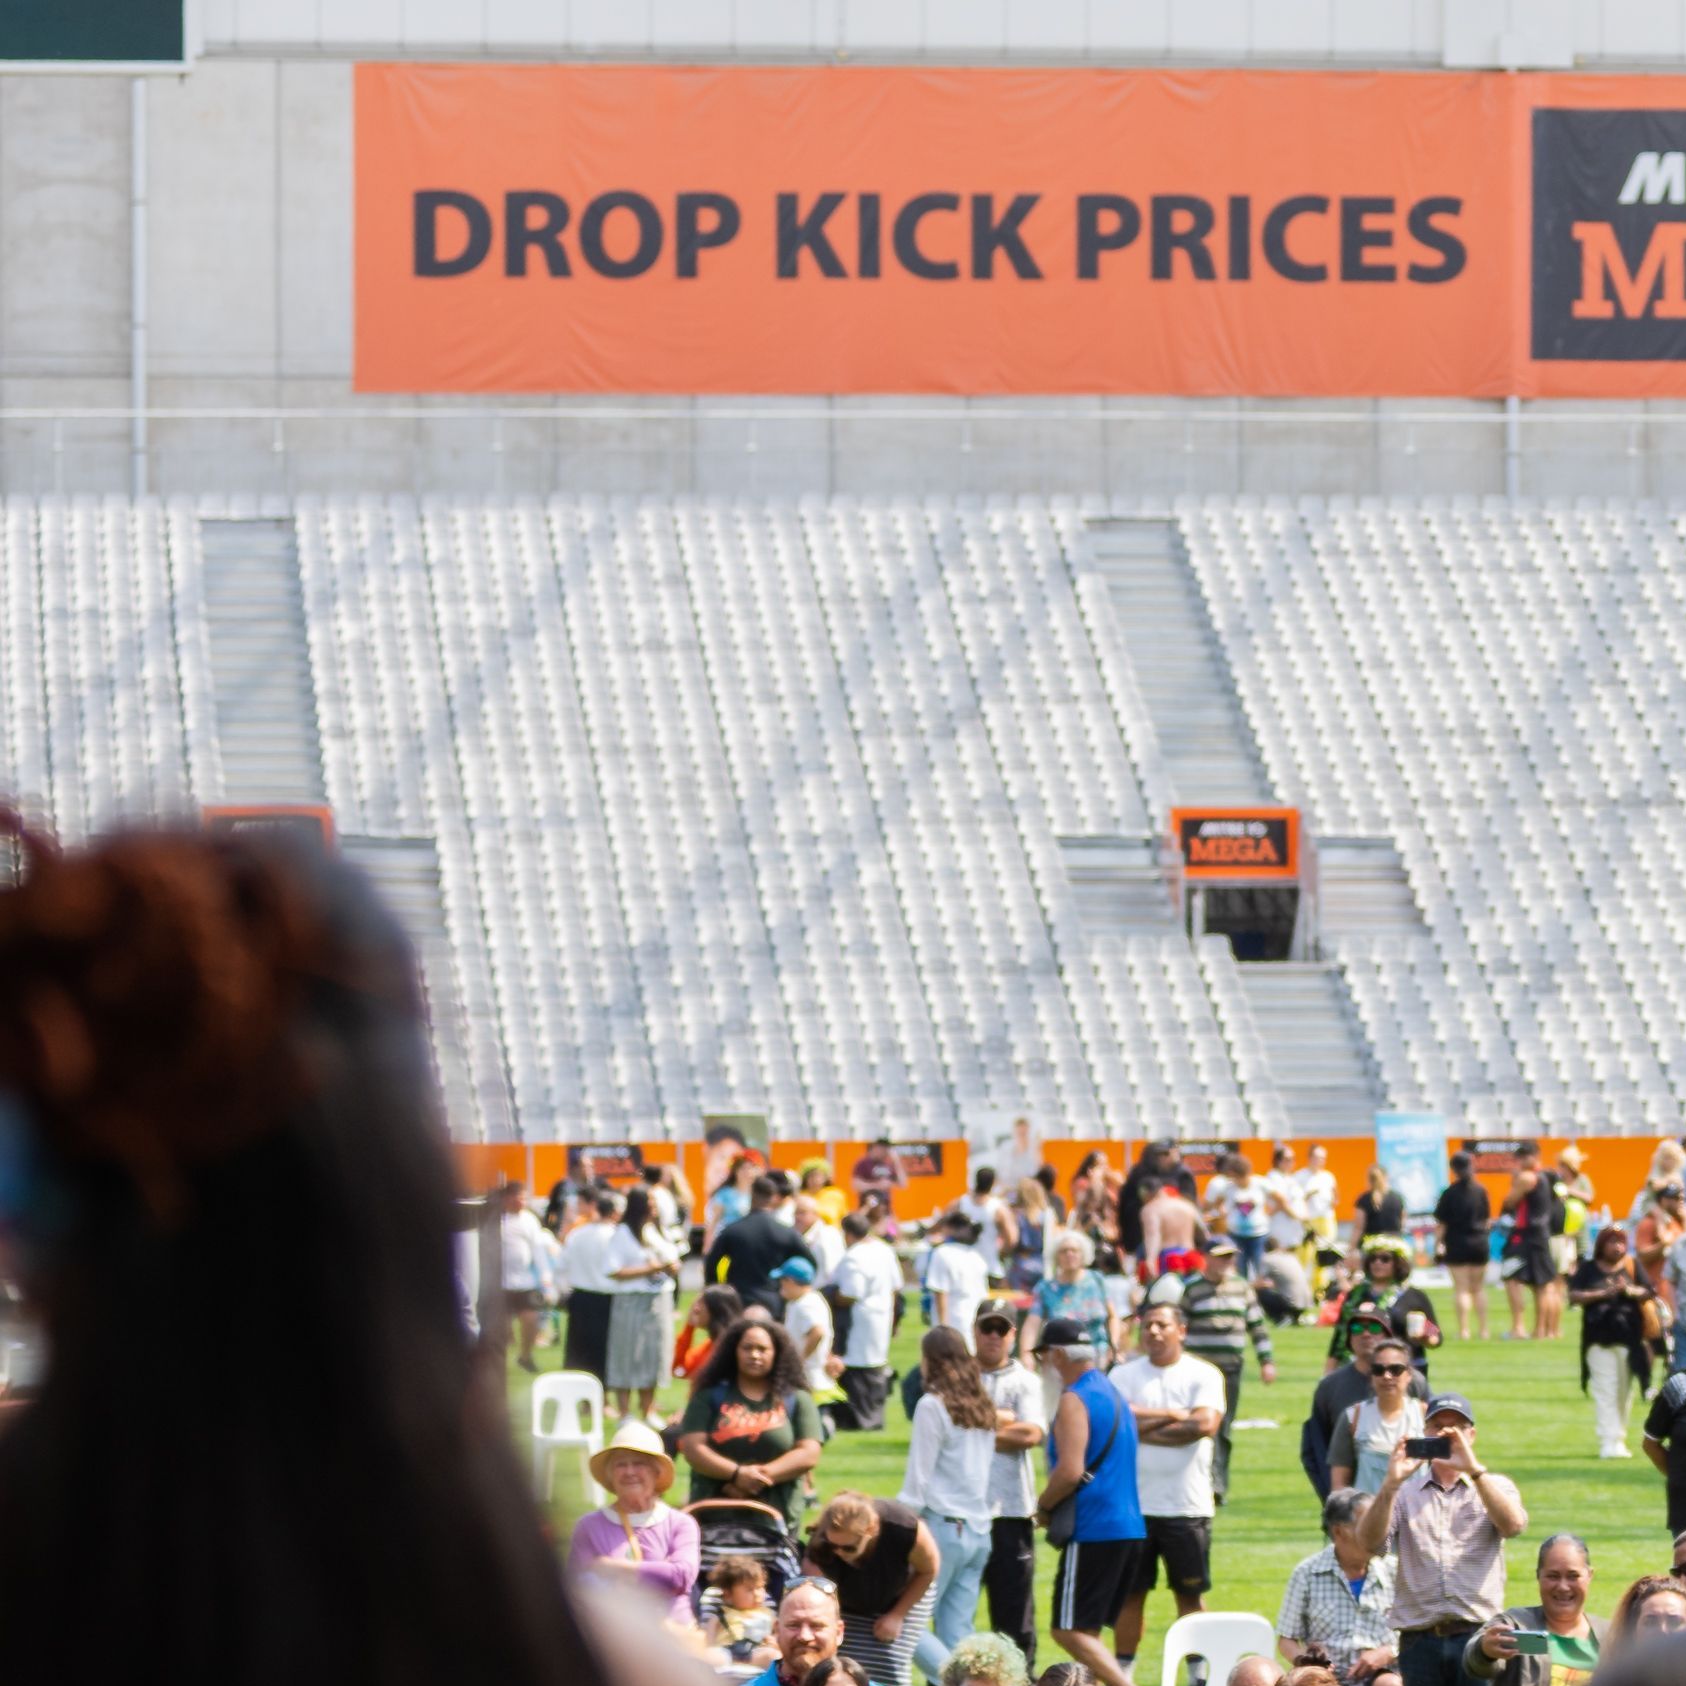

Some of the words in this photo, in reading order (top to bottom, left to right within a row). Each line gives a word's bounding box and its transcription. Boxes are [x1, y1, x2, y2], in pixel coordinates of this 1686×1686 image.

[413, 188, 742, 281] DROP
[776, 191, 1045, 282] KICK
[1076, 193, 1467, 284] PRICES
[1189, 837, 1278, 862] MEGA
